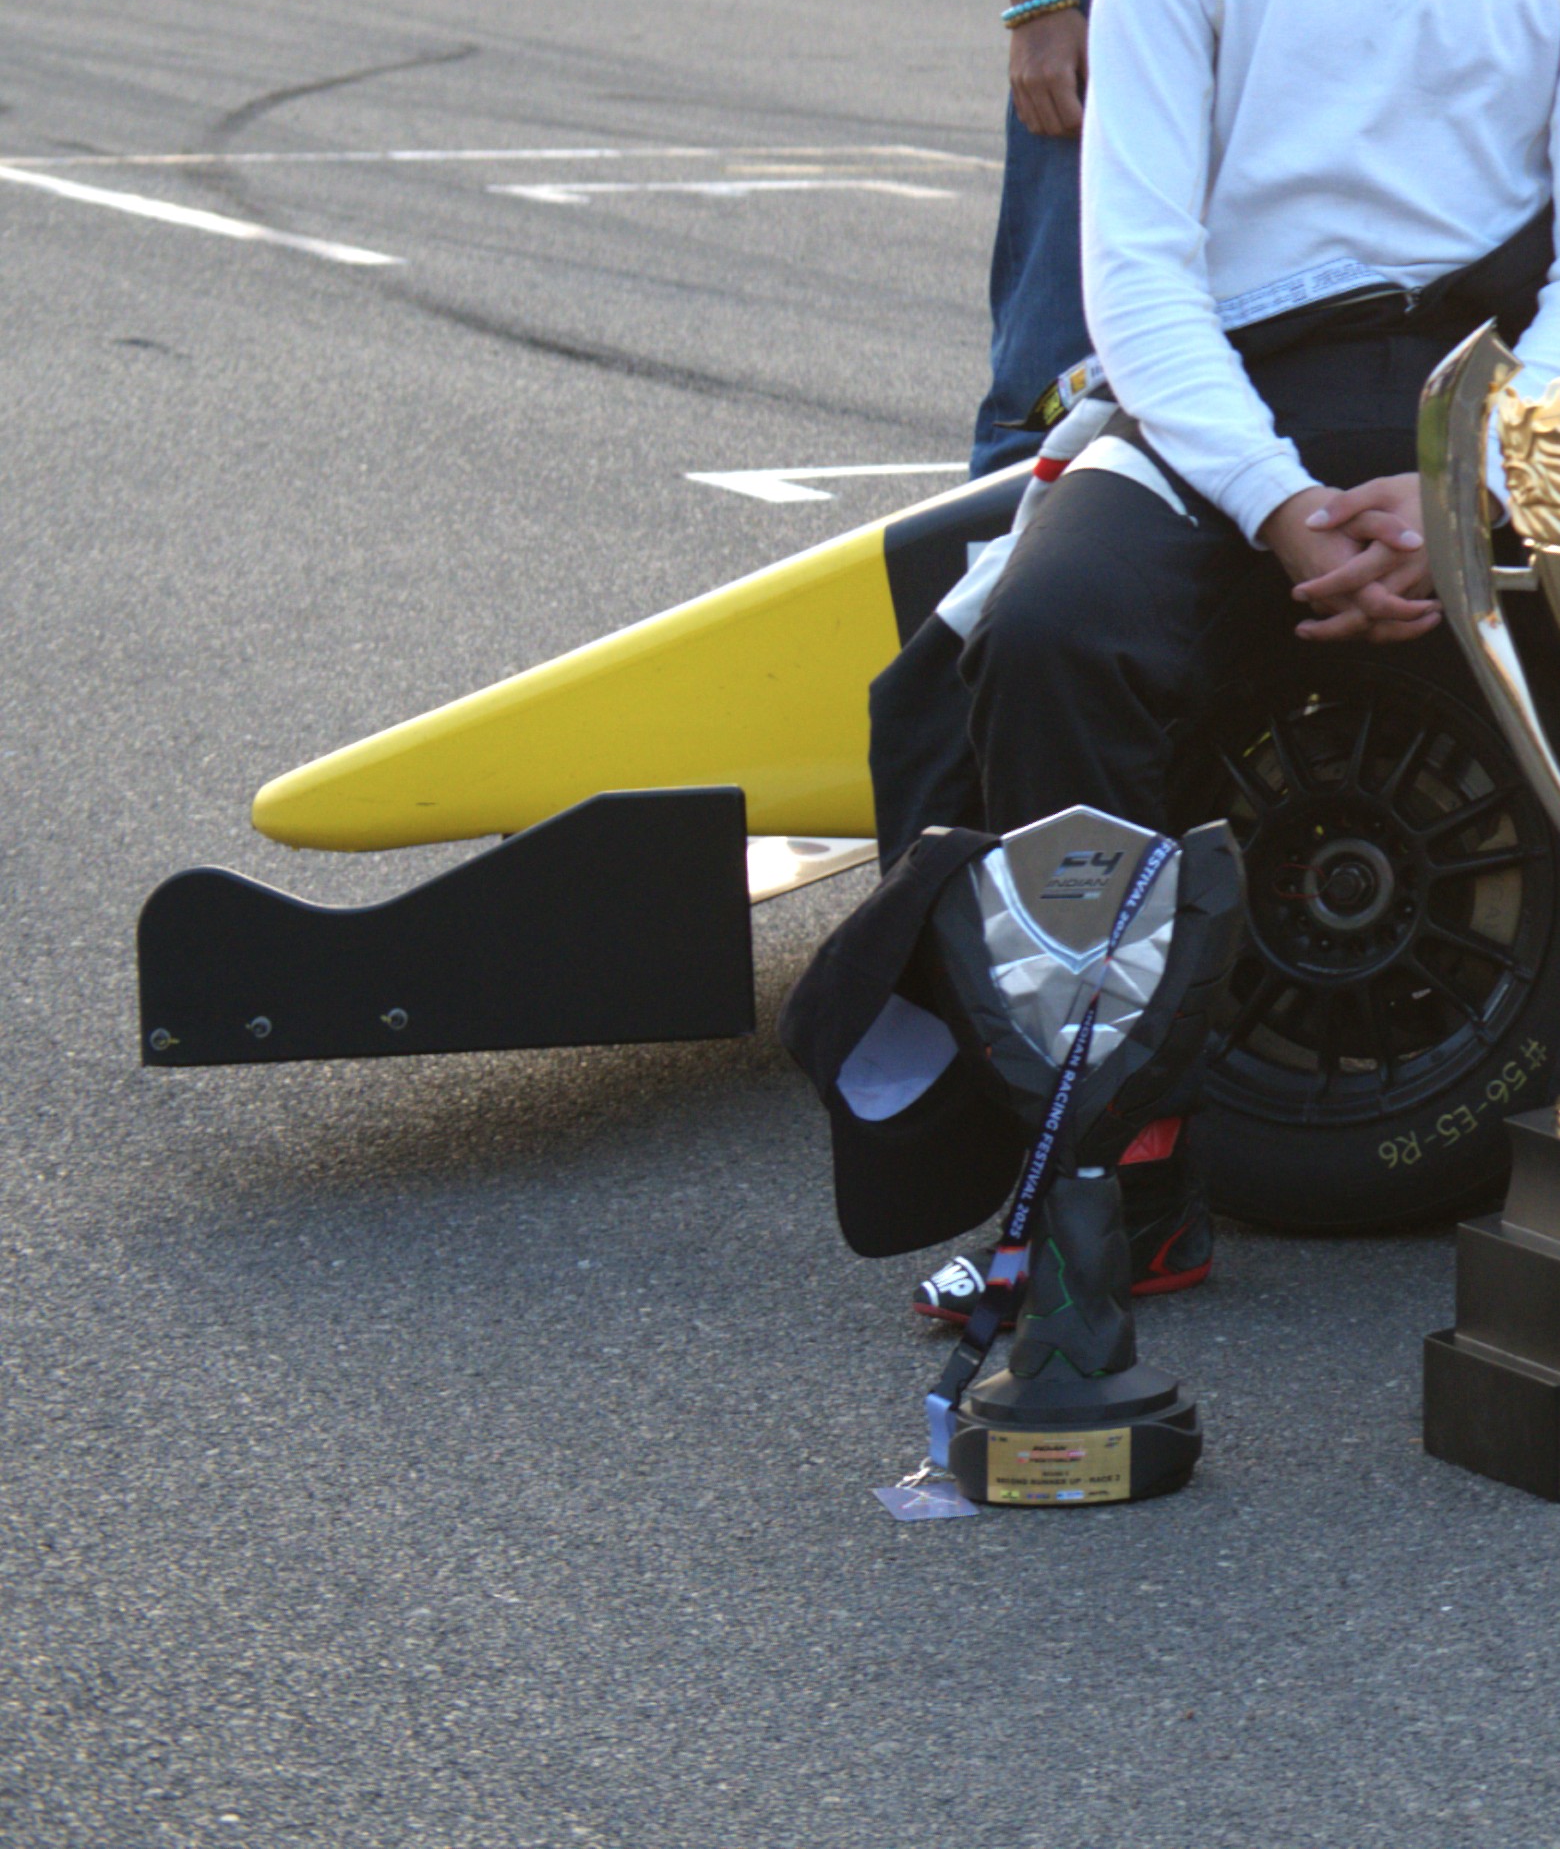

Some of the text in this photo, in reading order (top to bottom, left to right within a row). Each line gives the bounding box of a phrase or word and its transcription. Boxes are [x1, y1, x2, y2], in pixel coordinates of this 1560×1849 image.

[1055, 851, 1123, 877] F4
[1127, 839, 1173, 908] FESTIVAL
[1009, 1009, 1095, 1240] INDIAN RACING FESTIVAL 2025
[932, 1261, 975, 1298] MP
